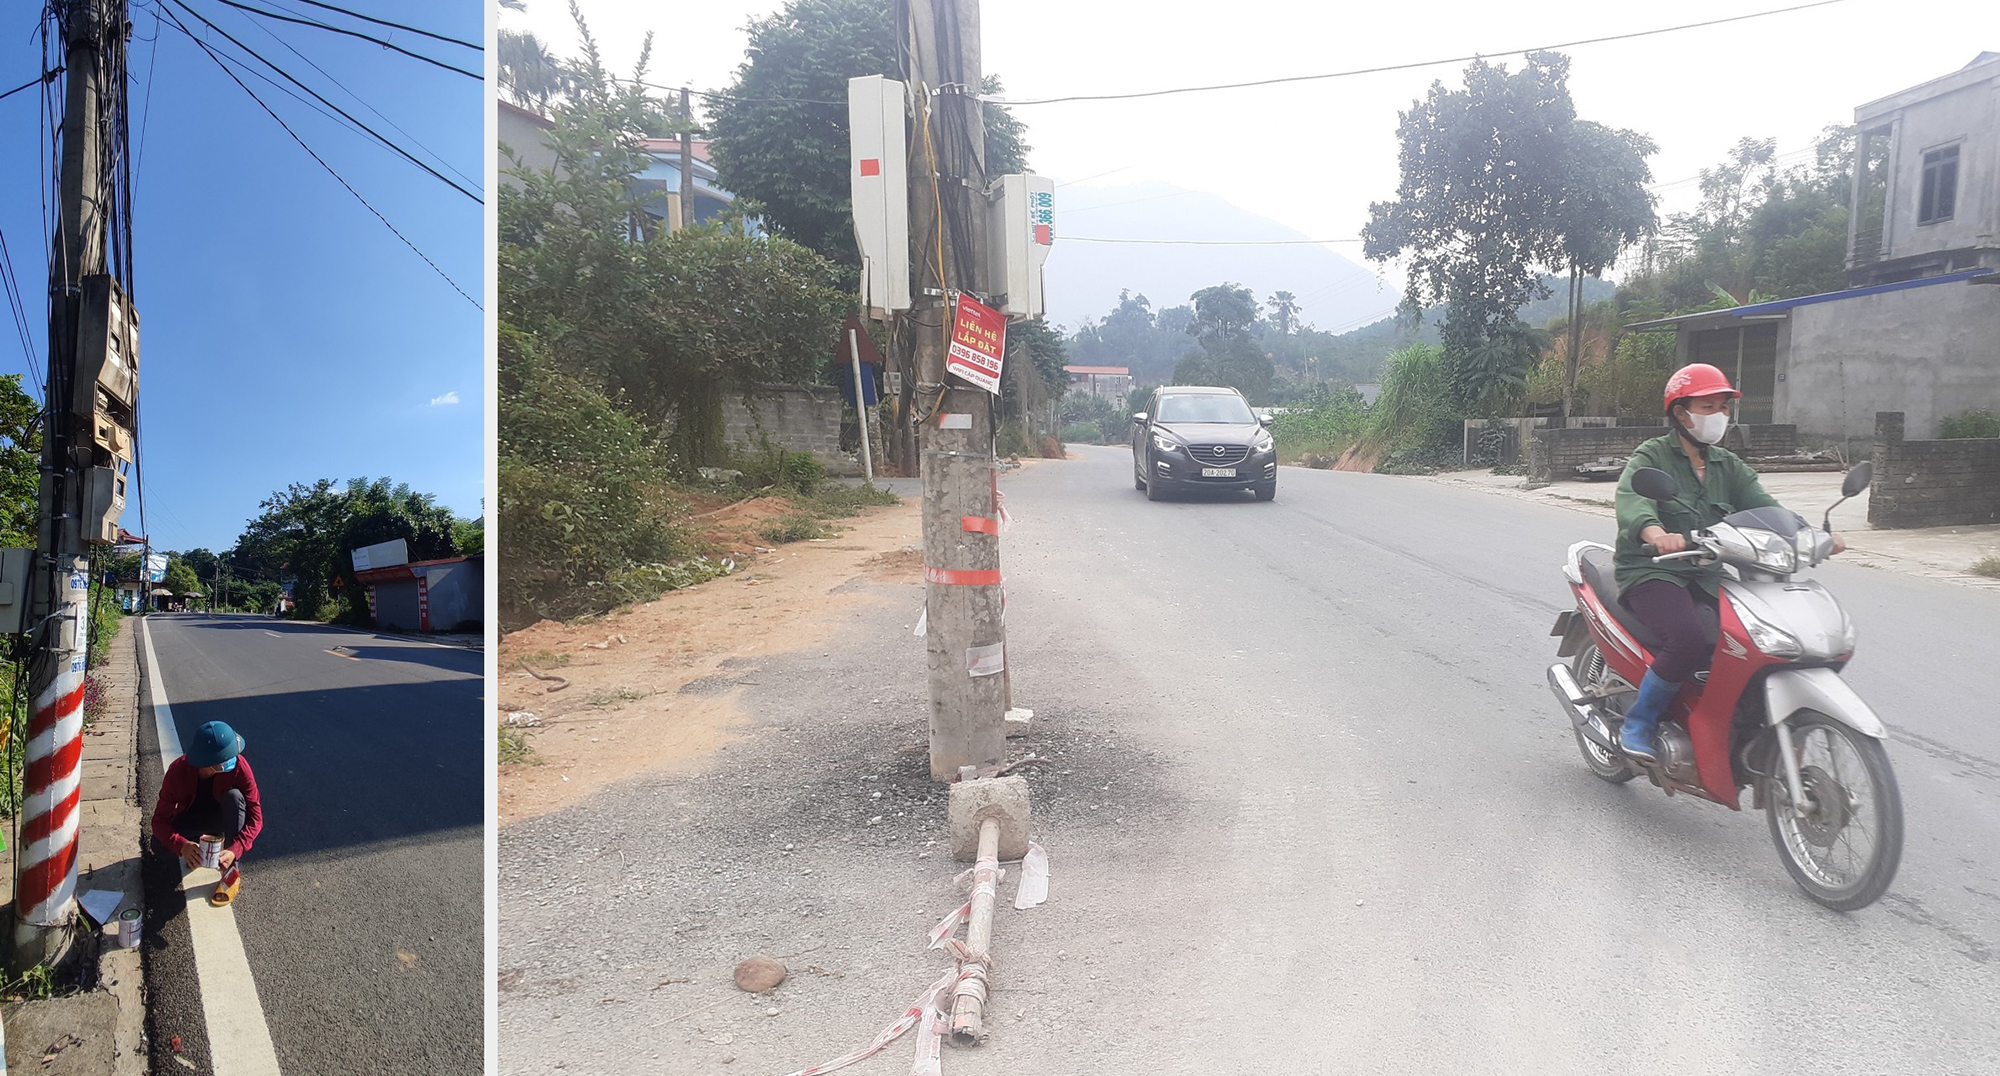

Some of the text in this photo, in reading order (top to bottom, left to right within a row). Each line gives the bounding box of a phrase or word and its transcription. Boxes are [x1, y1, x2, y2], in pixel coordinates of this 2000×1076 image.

[1038, 192, 1053, 246] .366.009
[958, 330, 997, 354] LẮP ĐẶT
[960, 318, 998, 342] LIÊN HỆ
[952, 344, 999, 370] 0396 858 196
